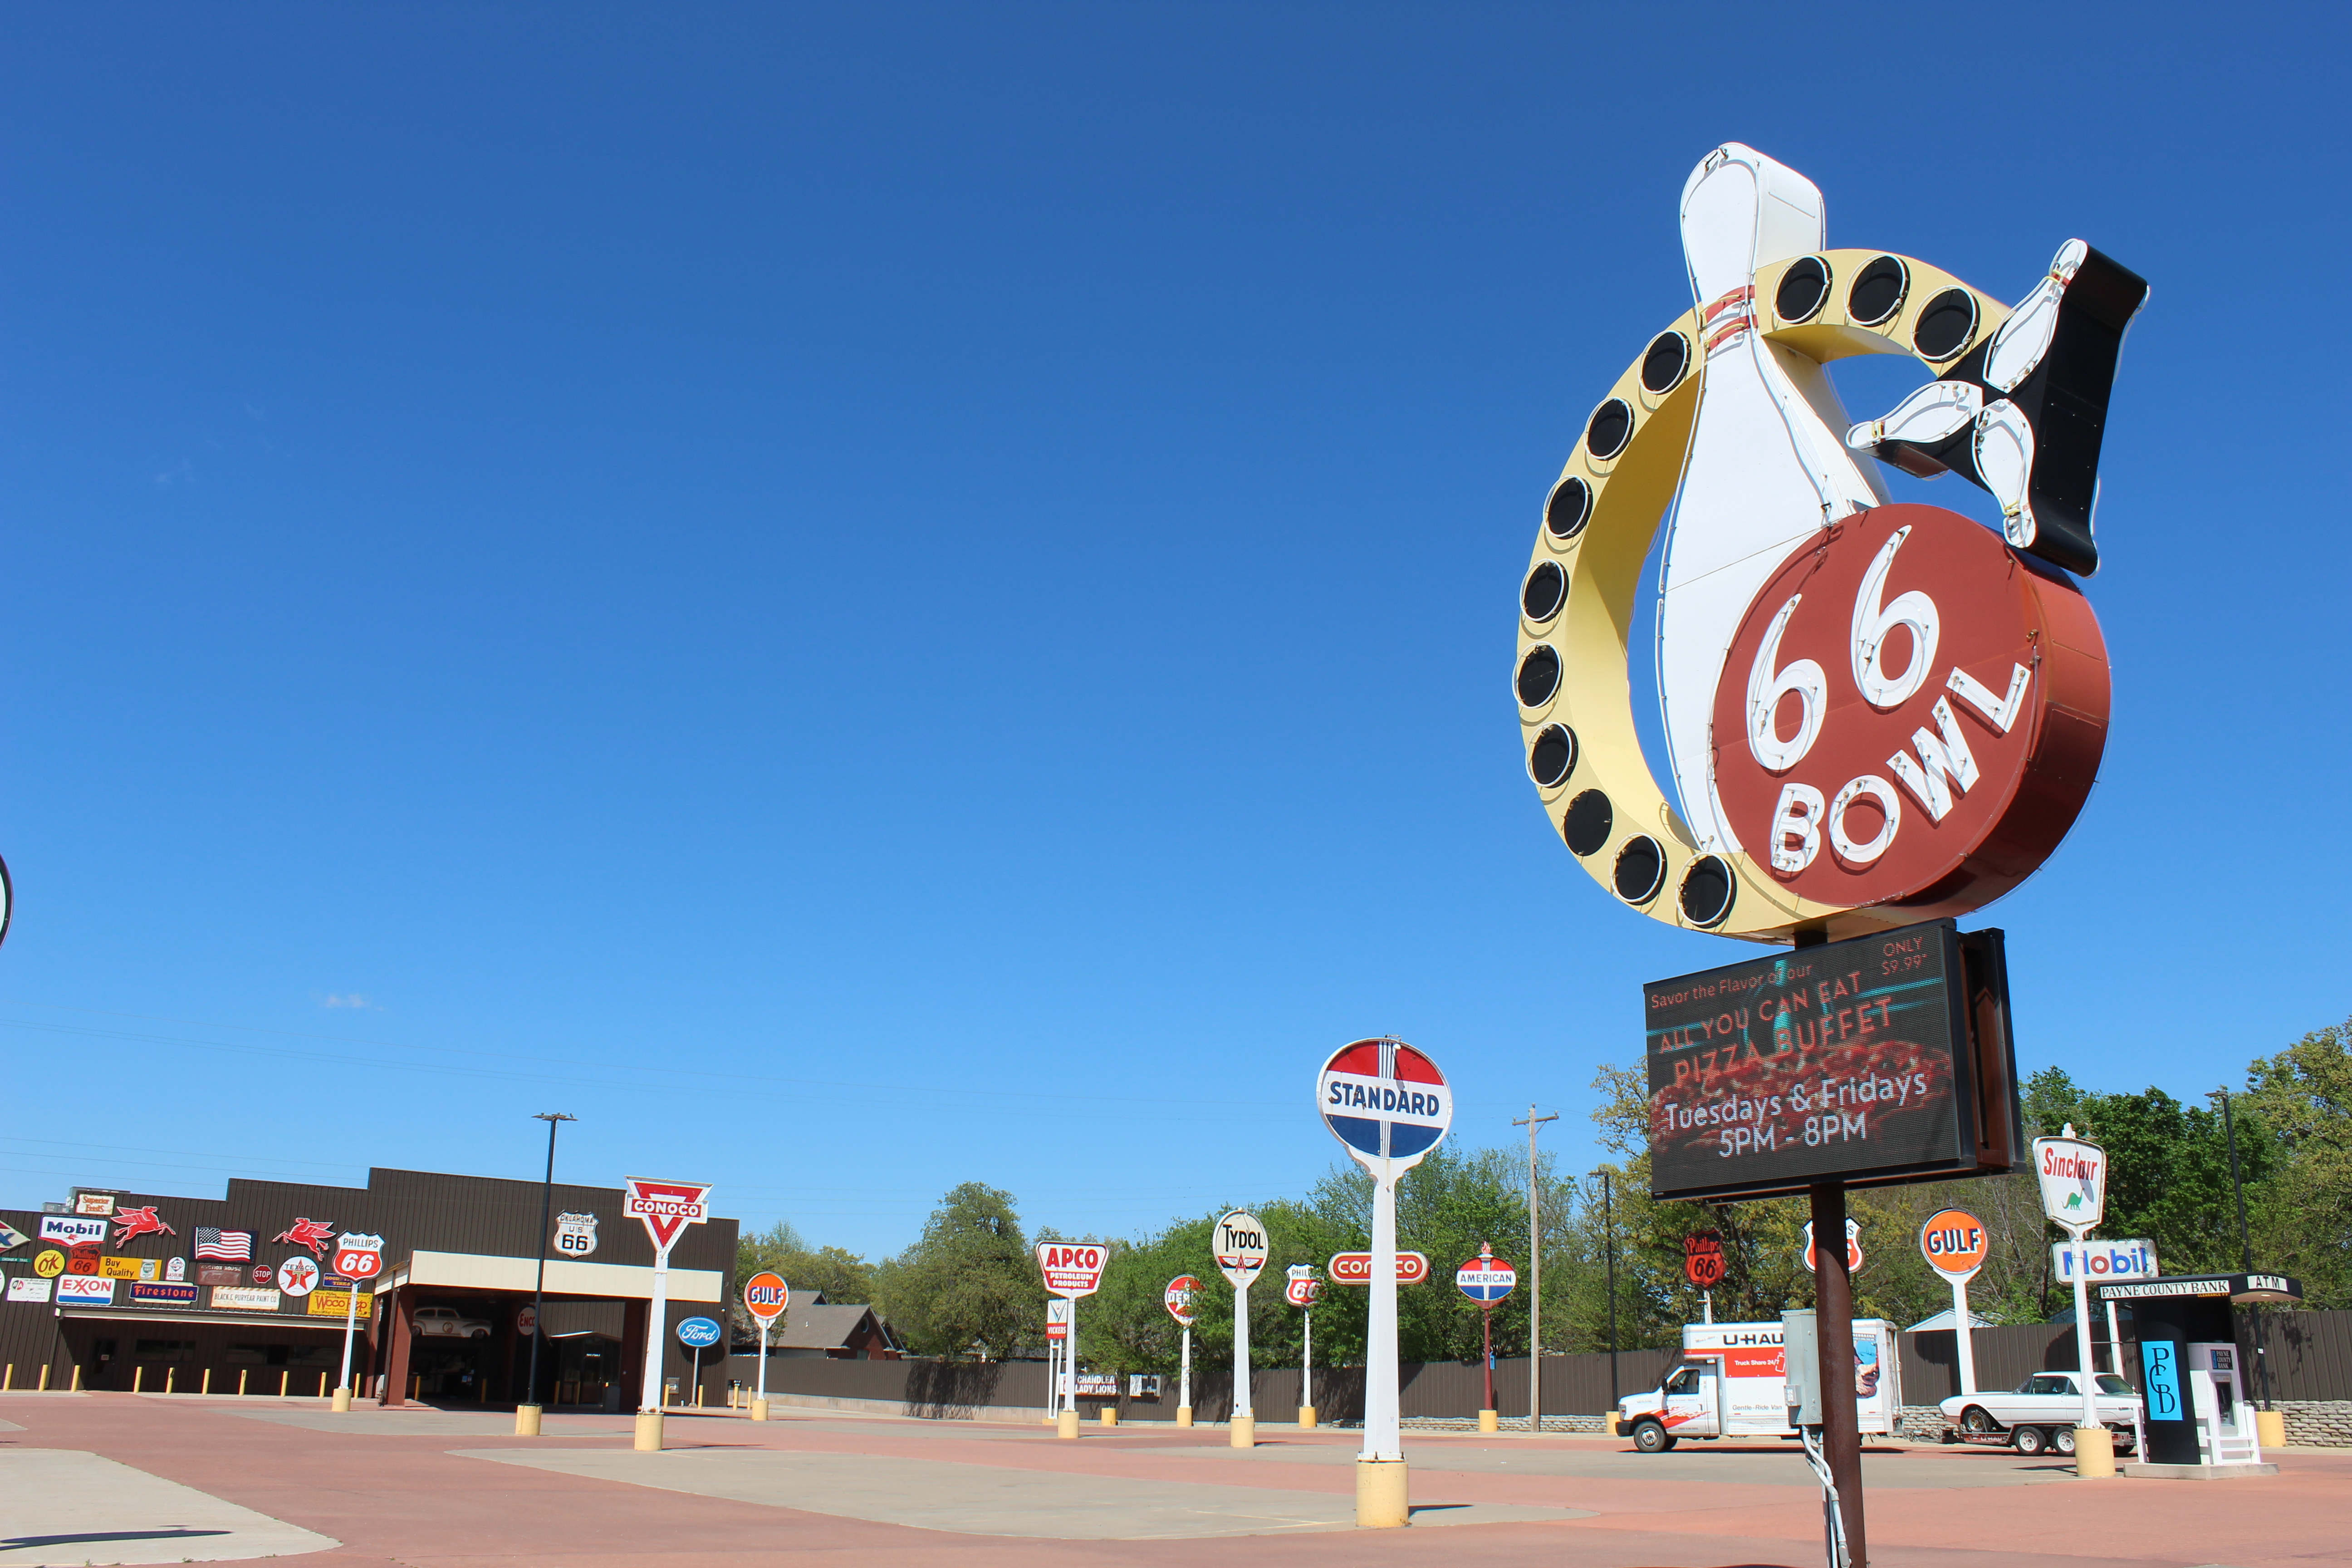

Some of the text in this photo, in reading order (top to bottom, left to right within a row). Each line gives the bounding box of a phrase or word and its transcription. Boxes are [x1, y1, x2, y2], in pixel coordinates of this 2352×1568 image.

[1746, 524, 1940, 771] 66
[1770, 662, 2031, 872] BOWL
[1883, 936, 1924, 957] ONLY
[1652, 991, 1690, 1009] Savor
[1693, 985, 1716, 1000] the
[1720, 975, 1764, 994] Flavor
[1788, 965, 1813, 980] our
[1660, 970, 1862, 1054] ALL YOU CAN EAT
[1674, 995, 1892, 1088] PIZZA BUFFET
[1329, 1081, 1440, 1117] STANDARD
[1664, 1071, 1927, 1131] Tuesdays & Fridays
[1719, 1126, 1775, 1157] 5PM
[1804, 1112, 1867, 1147] 8PM
[2043, 1147, 2097, 1181] Sinclair
[83, 1196, 109, 1205] Superior
[634, 1200, 699, 1216] CONOCO
[46, 1221, 102, 1235] Mobil
[560, 1215, 593, 1224] OKLAHOMA
[343, 1238, 378, 1248] PHILLIPS
[562, 1234, 588, 1251] 66
[1687, 1237, 1720, 1254] Phillips
[1927, 1228, 1981, 1255] GULF
[39, 1254, 59, 1272] OK
[74, 1249, 96, 1260] Phillips
[105, 1258, 120, 1268] Buy
[341, 1253, 375, 1272] 66
[1046, 1248, 1098, 1269] APCO
[74, 1260, 92, 1272] 66
[107, 1268, 135, 1278] Quality
[1338, 1260, 1417, 1274] conco
[1695, 1258, 1717, 1279] 66
[293, 1271, 306, 1284] T
[1050, 1272, 1093, 1280] PETROLEUM
[1053, 1279, 1088, 1288] PRODUCTS
[1460, 1274, 1512, 1283] AMERICAN
[2256, 1275, 2280, 1289] ATM
[62, 1278, 112, 1295] EXXON
[134, 1285, 194, 1298] Firestone
[2102, 1281, 2228, 1298] PAYNE COUNTY BANK
[750, 1286, 784, 1305] GULF
[682, 1324, 716, 1341] Ford
[1048, 1326, 1066, 1334] VICKERS
[1723, 1333, 1784, 1345] U-HAU
[1077, 1375, 1115, 1384] CHANDLER
[1075, 1384, 1117, 1394] LADY LIONS
